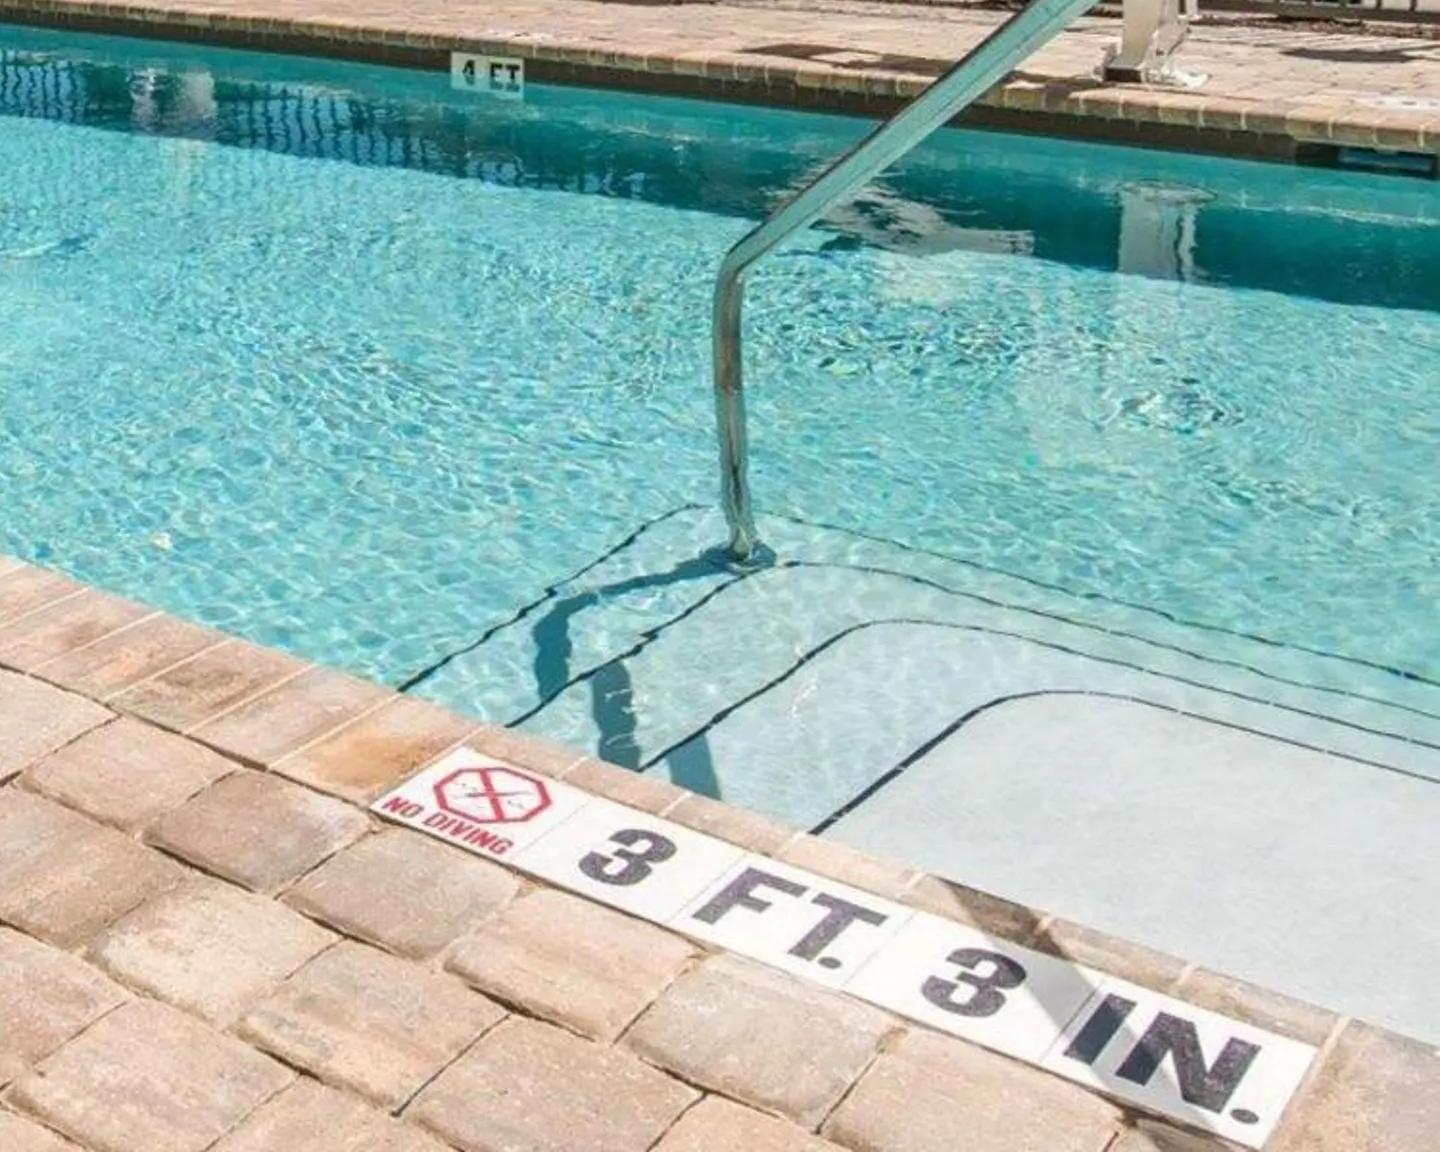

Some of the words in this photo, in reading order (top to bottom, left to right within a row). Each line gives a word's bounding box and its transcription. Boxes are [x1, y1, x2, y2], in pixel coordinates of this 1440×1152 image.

[381, 795, 425, 819] NO
[422, 811, 514, 855] DIVING
[578, 828, 678, 887] 3
[691, 866, 889, 971] FT.
[920, 947, 1027, 1018] 3
[1062, 993, 1263, 1126] IN.
